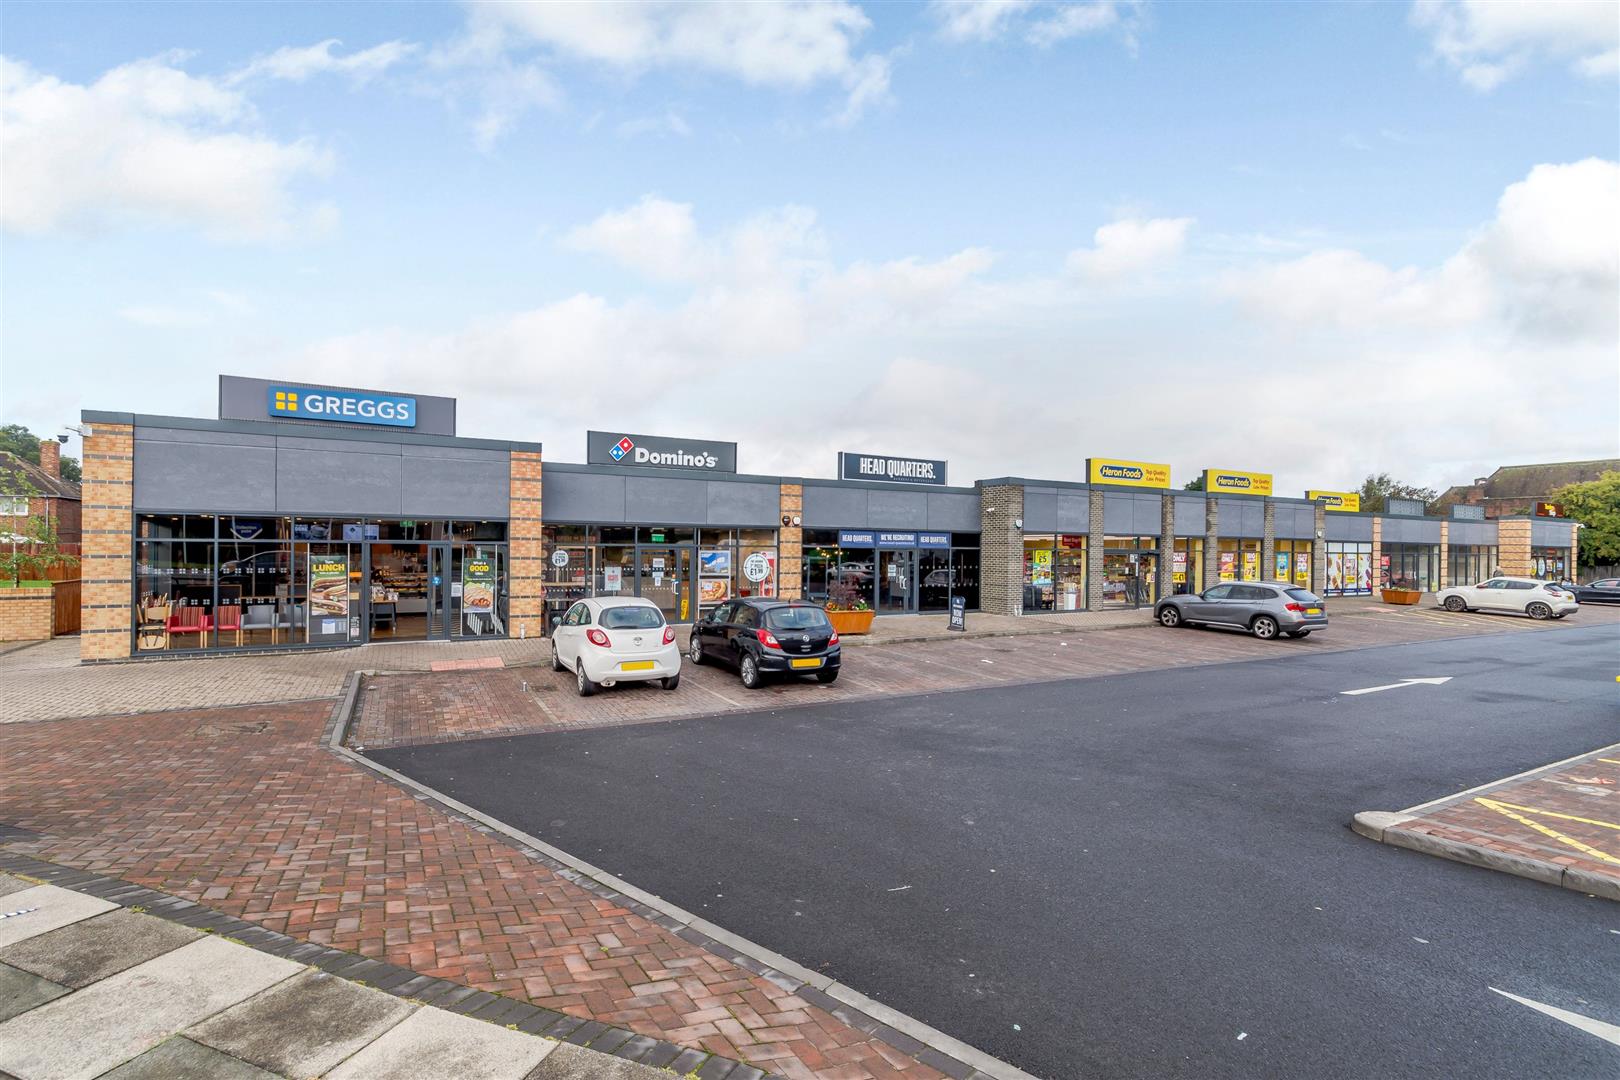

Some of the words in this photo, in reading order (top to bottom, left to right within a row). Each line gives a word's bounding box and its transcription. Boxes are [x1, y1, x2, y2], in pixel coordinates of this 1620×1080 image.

[304, 394, 409, 420] GREGGS
[634, 447, 717, 467] Domino's
[859, 457, 886, 475] HEAD
[887, 459, 936, 479] QUARTERS.
[1102, 466, 1122, 477] Heron
[1123, 468, 1141, 479] Foods
[1218, 477, 1234, 486] Heron
[1235, 478, 1249, 487] Foods
[313, 564, 345, 572] LUNCH
[952, 616, 963, 625] OPEN
